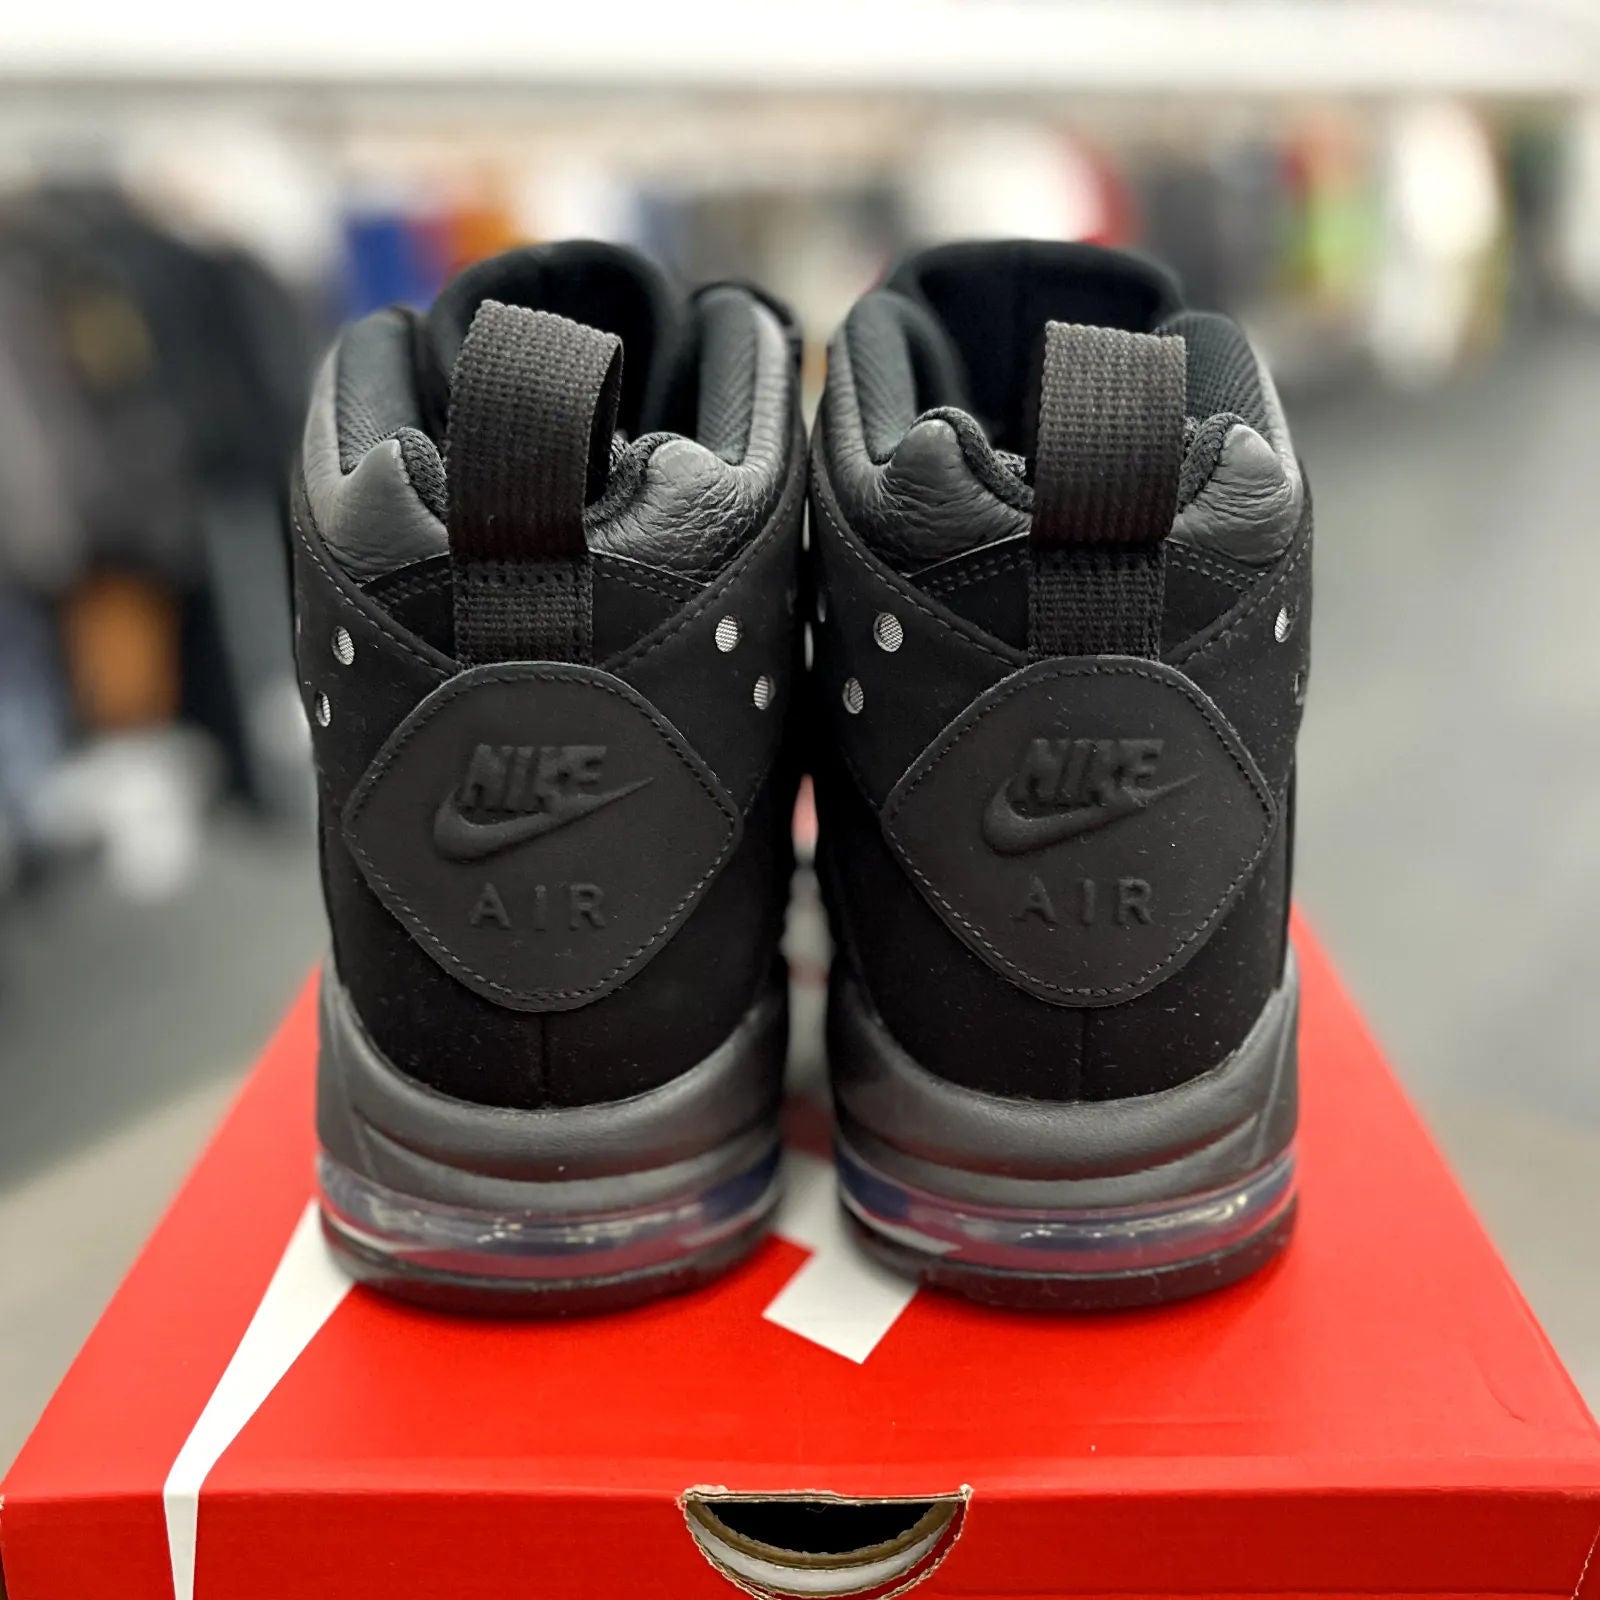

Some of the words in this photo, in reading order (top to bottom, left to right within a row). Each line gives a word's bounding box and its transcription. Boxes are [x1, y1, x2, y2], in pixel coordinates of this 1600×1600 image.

[456, 743, 607, 811] NIKE
[1008, 738, 1165, 805] NIKE
[468, 882, 606, 931] AIR
[1011, 873, 1154, 926] AIR
